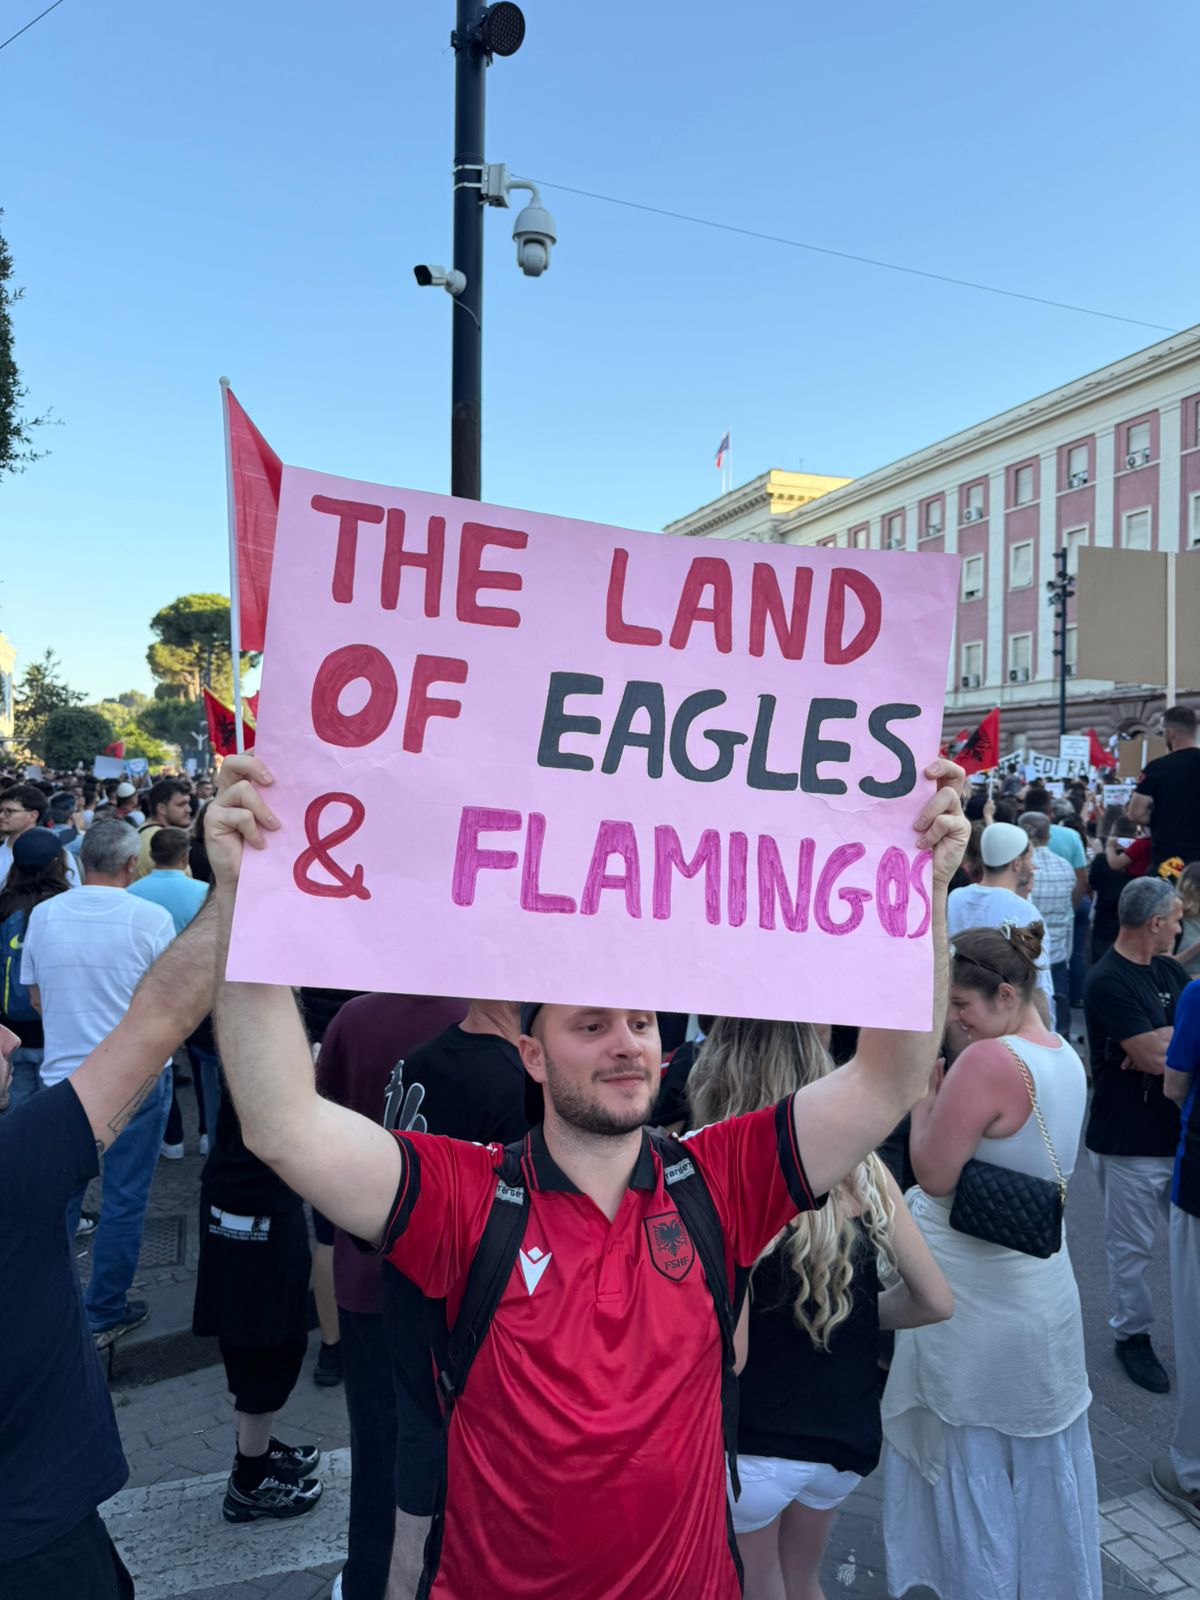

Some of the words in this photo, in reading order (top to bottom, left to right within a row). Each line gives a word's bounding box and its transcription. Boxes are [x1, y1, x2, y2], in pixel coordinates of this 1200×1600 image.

[311, 495, 529, 628] THE
[606, 548, 882, 665] LAND
[311, 644, 468, 753] OF
[537, 671, 921, 799] EAGLES
[293, 792, 371, 900] &
[452, 807, 933, 939] FLAMINGOS
[665, 1256, 689, 1270] FSHF
